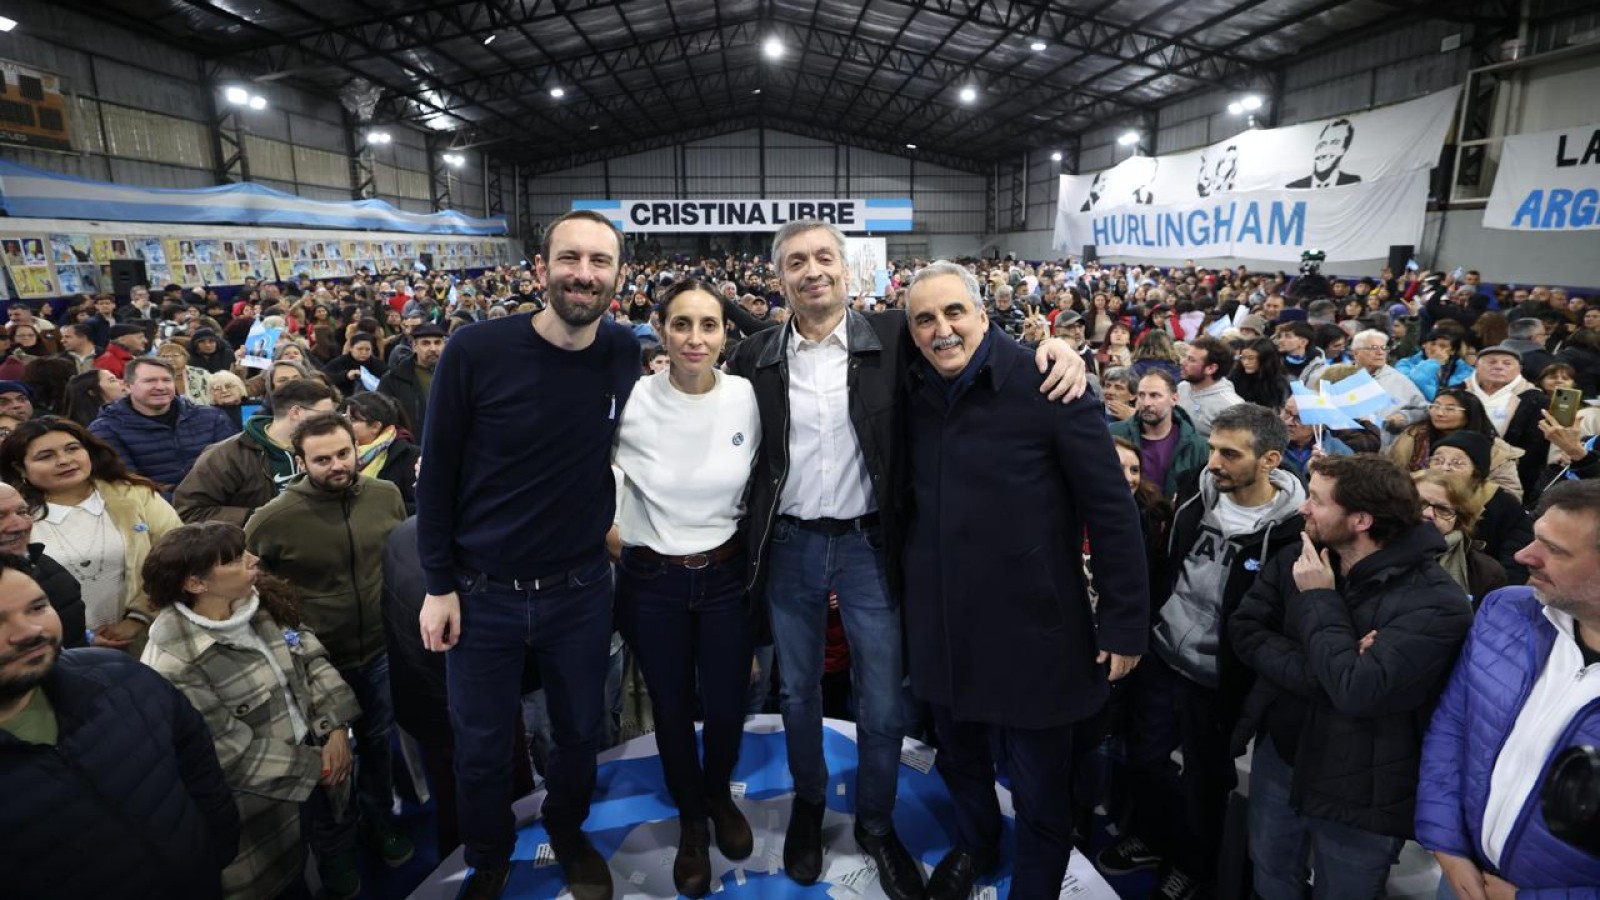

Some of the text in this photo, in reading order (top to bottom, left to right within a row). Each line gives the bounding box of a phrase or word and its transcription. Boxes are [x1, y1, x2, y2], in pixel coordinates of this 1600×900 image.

[1556, 129, 1600, 168] LA
[630, 202, 855, 226] CRISTINA LIBRE
[1092, 200, 1307, 247] HURLINGHAM
[1511, 188, 1600, 229] ARG
